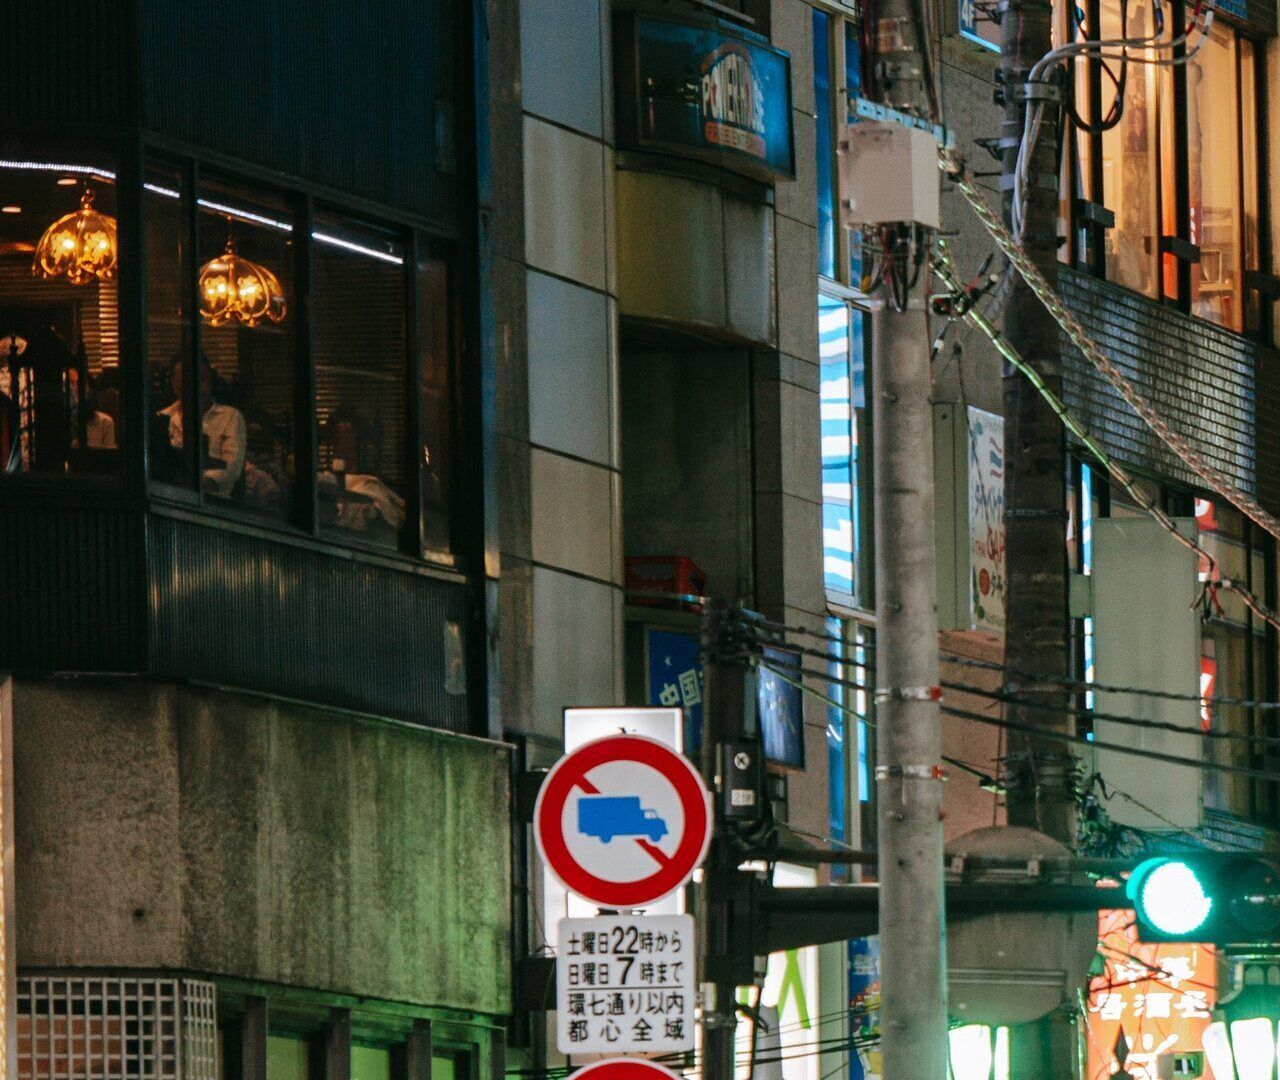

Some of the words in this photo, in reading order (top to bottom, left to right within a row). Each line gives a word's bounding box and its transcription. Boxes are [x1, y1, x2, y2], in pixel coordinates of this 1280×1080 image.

[659, 669, 702, 707] 中国
[567, 925, 681, 956] 土曜日22時から
[568, 957, 683, 986] 日曜日7時まで
[567, 992, 684, 1016] 環七通り以内
[567, 1018, 684, 1042] 都心全域
